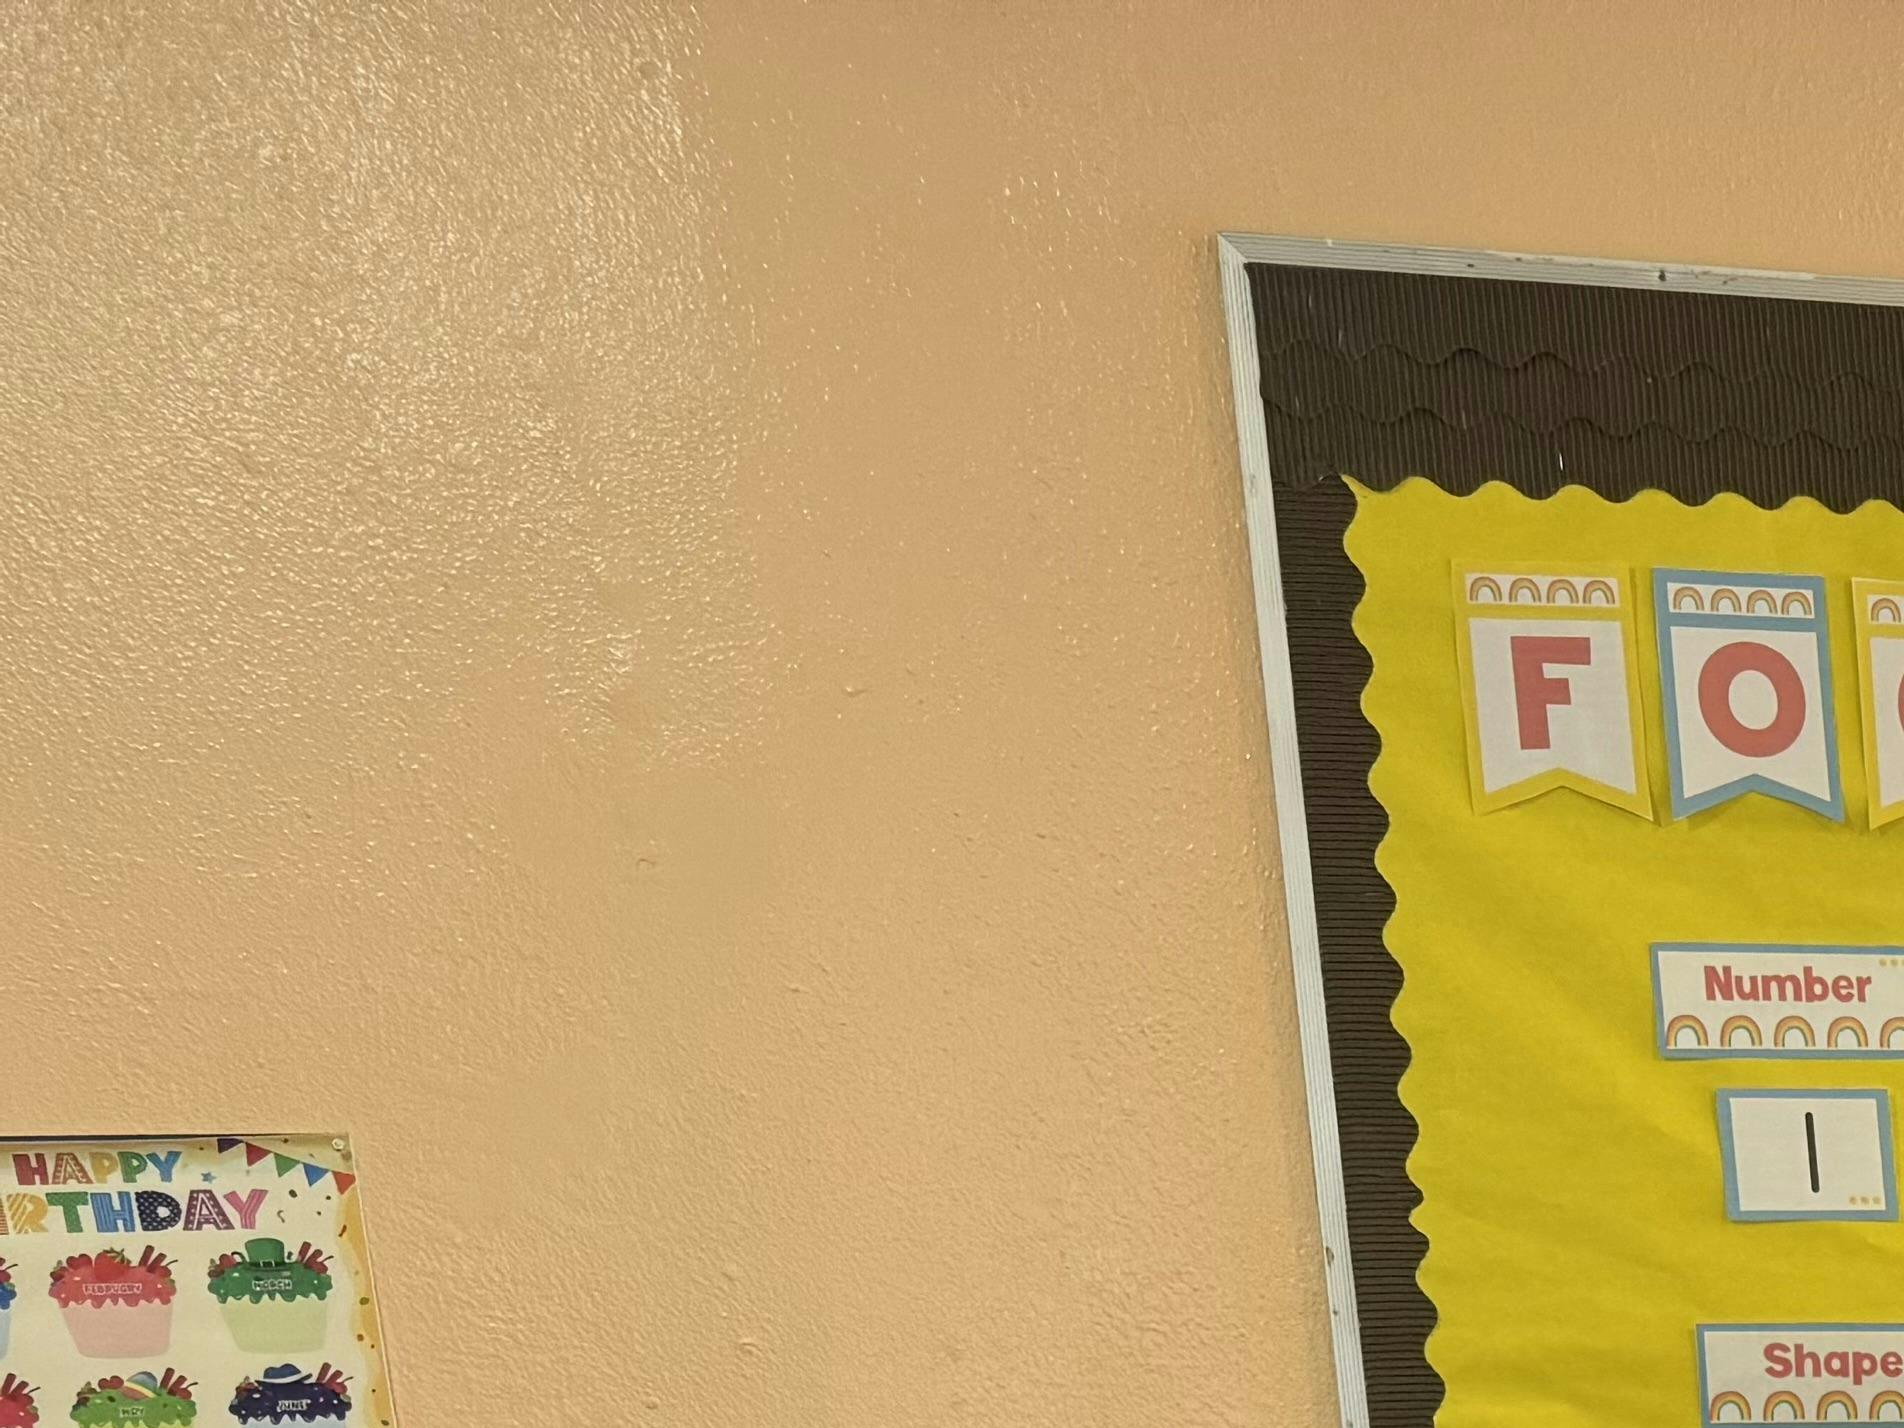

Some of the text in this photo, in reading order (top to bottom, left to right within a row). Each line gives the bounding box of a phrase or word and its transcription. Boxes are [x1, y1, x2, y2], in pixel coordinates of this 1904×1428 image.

[1703, 965, 1872, 1003] Number
[12, 1150, 182, 1186] HAPPY
[1763, 1342, 1903, 1386] Shape
